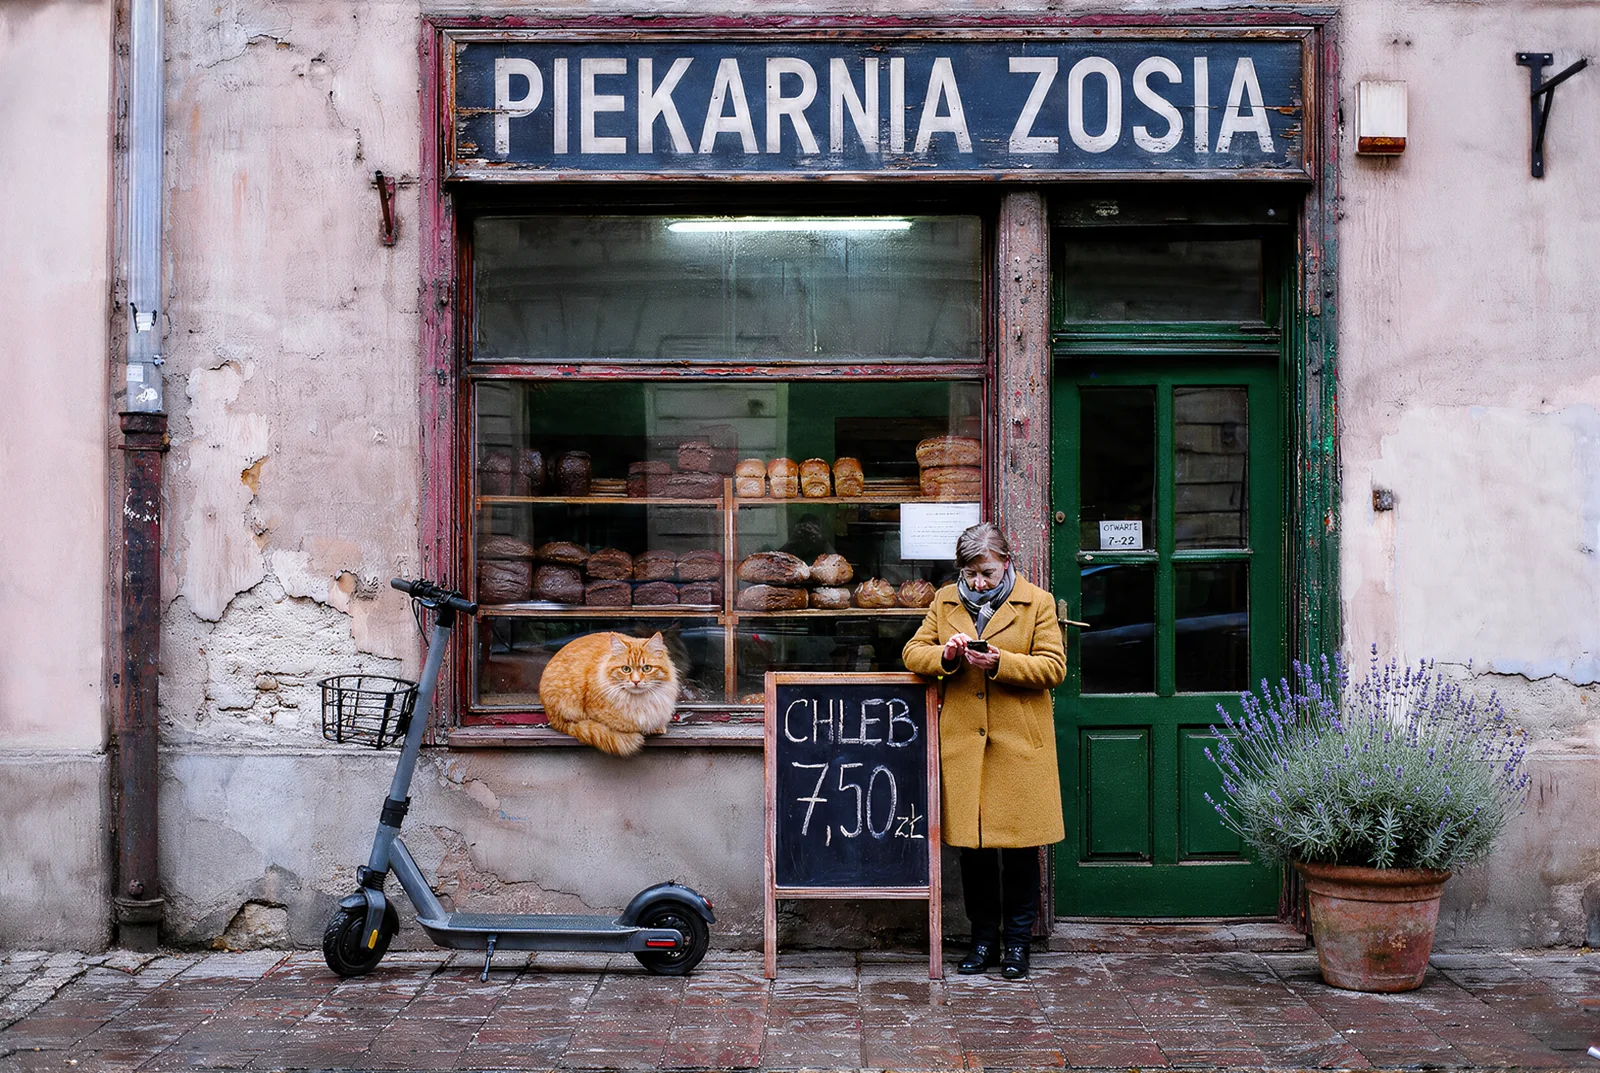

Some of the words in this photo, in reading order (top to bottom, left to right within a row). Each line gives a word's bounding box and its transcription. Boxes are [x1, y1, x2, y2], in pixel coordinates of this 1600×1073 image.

[494, 56, 972, 155] PIEKARNIA
[1007, 56, 1276, 155] ZOSIA
[784, 698, 919, 748] CHLEB
[792, 762, 897, 846] 7,50
